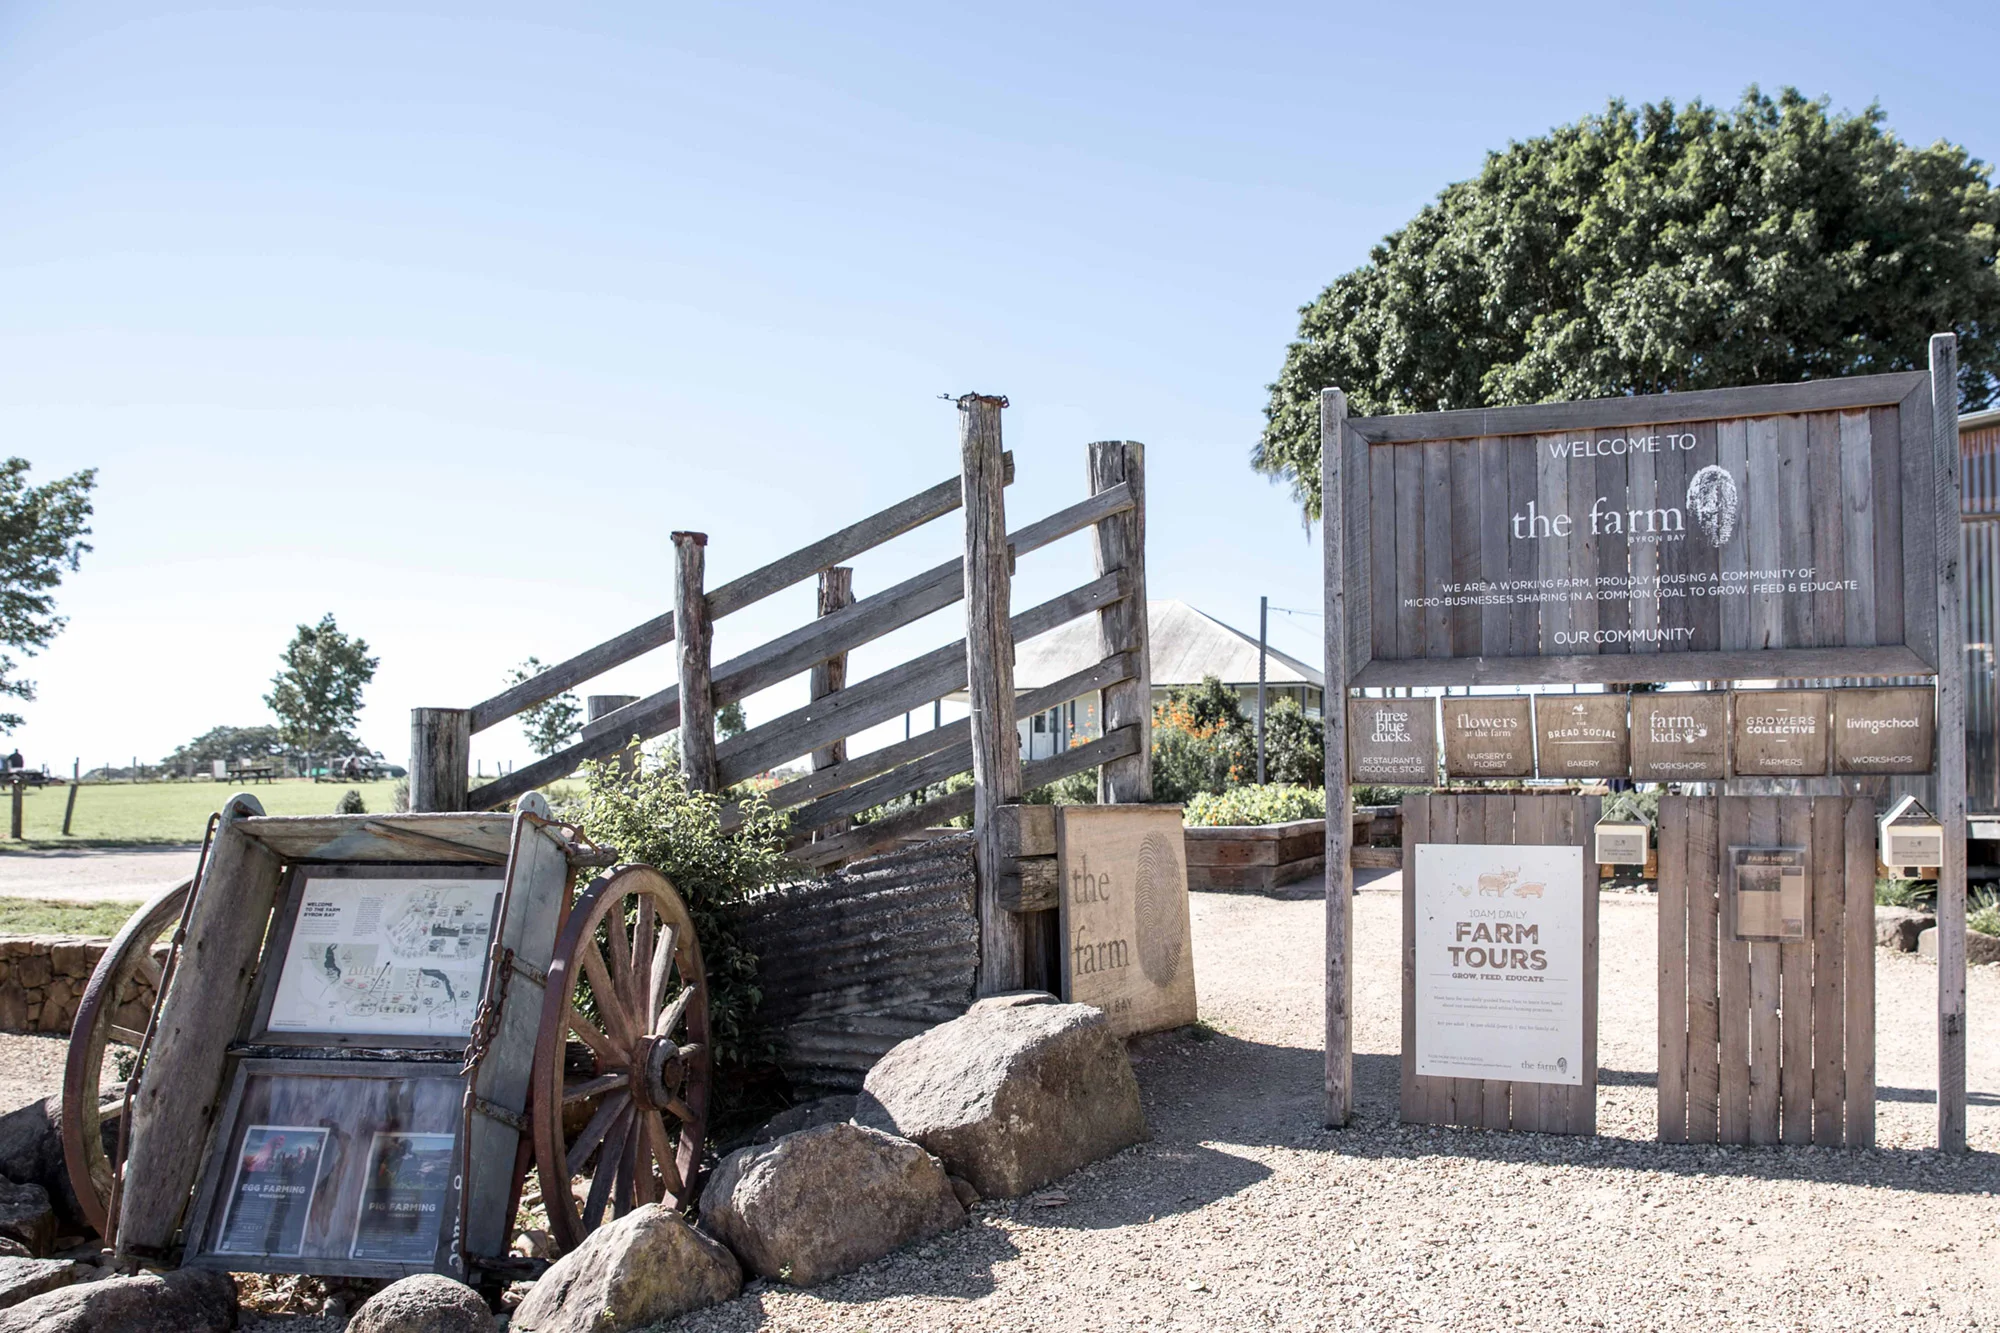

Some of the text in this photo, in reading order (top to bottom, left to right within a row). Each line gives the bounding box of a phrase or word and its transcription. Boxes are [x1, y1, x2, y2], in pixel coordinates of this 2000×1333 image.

[1550, 433, 1696, 458] WELCOME TO
[1512, 497, 1685, 539] the farm
[1629, 534, 1686, 544] BYRON BAY
[1443, 583, 1461, 593] WE
[1464, 582, 1487, 592] ARE
[1489, 582, 1498, 591] A
[1500, 579, 1554, 591] WORKING
[1596, 576, 1649, 586] PROUDLY
[1653, 573, 1706, 584] HOUSING
[1709, 572, 1718, 582] A
[1721, 568, 1796, 582] COMMUNITY
[1798, 568, 1816, 578] OF
[1404, 595, 1514, 607] MICRO-BUSINESSES
[1517, 592, 1567, 604] SHARING
[1570, 592, 1582, 601] IN
[1585, 591, 1594, 600] A
[1596, 588, 1650, 600] COMMON
[1653, 588, 1686, 598] GOAL
[1689, 586, 1706, 597] TO
[1753, 583, 1785, 594] FEED
[1788, 582, 1797, 592] &
[1554, 627, 1695, 645] OUR COMMUNITY
[1375, 709, 1408, 722] three
[1457, 713, 1518, 729] flowers
[1650, 710, 1695, 728] farm
[1746, 716, 1816, 725] GROWERS
[1376, 720, 1404, 733] blue
[1746, 726, 1816, 734] COLLECTIVE
[1847, 717, 1920, 734] livingschool
[1474, 729, 1488, 737] the
[1490, 729, 1511, 737] farm
[1548, 728, 1616, 739] BREAD SOCIAL
[1650, 728, 1682, 743] kids
[1363, 757, 1415, 765] RESTAURANT
[1473, 760, 1507, 768] FLORIST
[1650, 762, 1707, 770] WORKSHOPS
[1760, 758, 1803, 766] FARMERS
[1852, 756, 1913, 764] WORKSHOPS
[1359, 765, 1426, 773] PRODUCE STORE
[1072, 854, 1110, 904] the
[1469, 909, 1527, 919] 10AM DAILY
[1456, 922, 1539, 945] FARM
[1075, 925, 1130, 976] farm
[1447, 946, 1548, 971] TOURS
[1452, 973, 1479, 981] GROW,
[1480, 974, 1503, 982] FEED,
[1115, 997, 1132, 1013] BAY
[1521, 1060, 1535, 1070] the
[1537, 1061, 1557, 1071] farm
[242, 1184, 306, 1194] EGG FARMING
[368, 1202, 436, 1212] PIG FARMING
